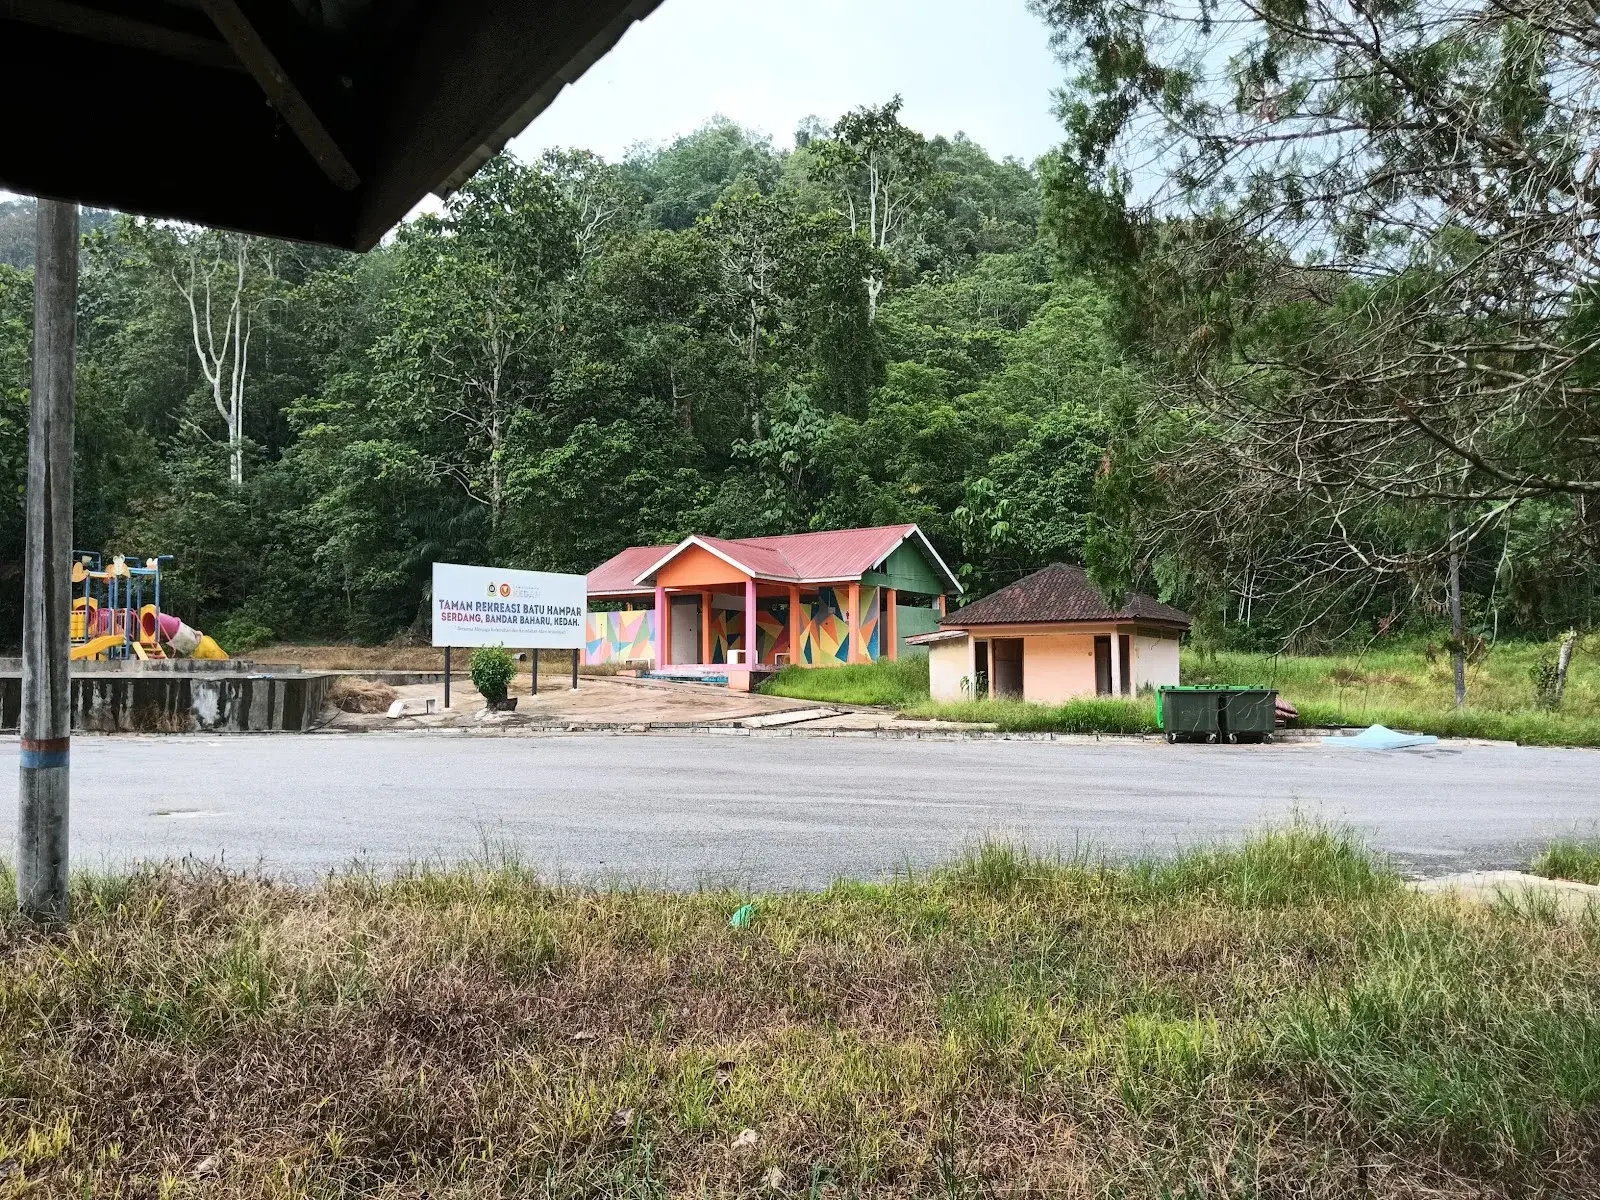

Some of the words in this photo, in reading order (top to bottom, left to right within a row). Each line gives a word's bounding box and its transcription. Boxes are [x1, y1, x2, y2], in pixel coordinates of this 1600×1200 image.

[439, 599, 473, 611] TAMAN
[475, 601, 521, 614] REKREASI
[523, 604, 545, 615] BATU
[547, 605, 582, 617] HAMPAR
[441, 612, 483, 623] SERDANG,
[486, 614, 518, 624] BANDAR
[520, 616, 552, 626] BAHARU,
[554, 617, 580, 627] KEDAH.
